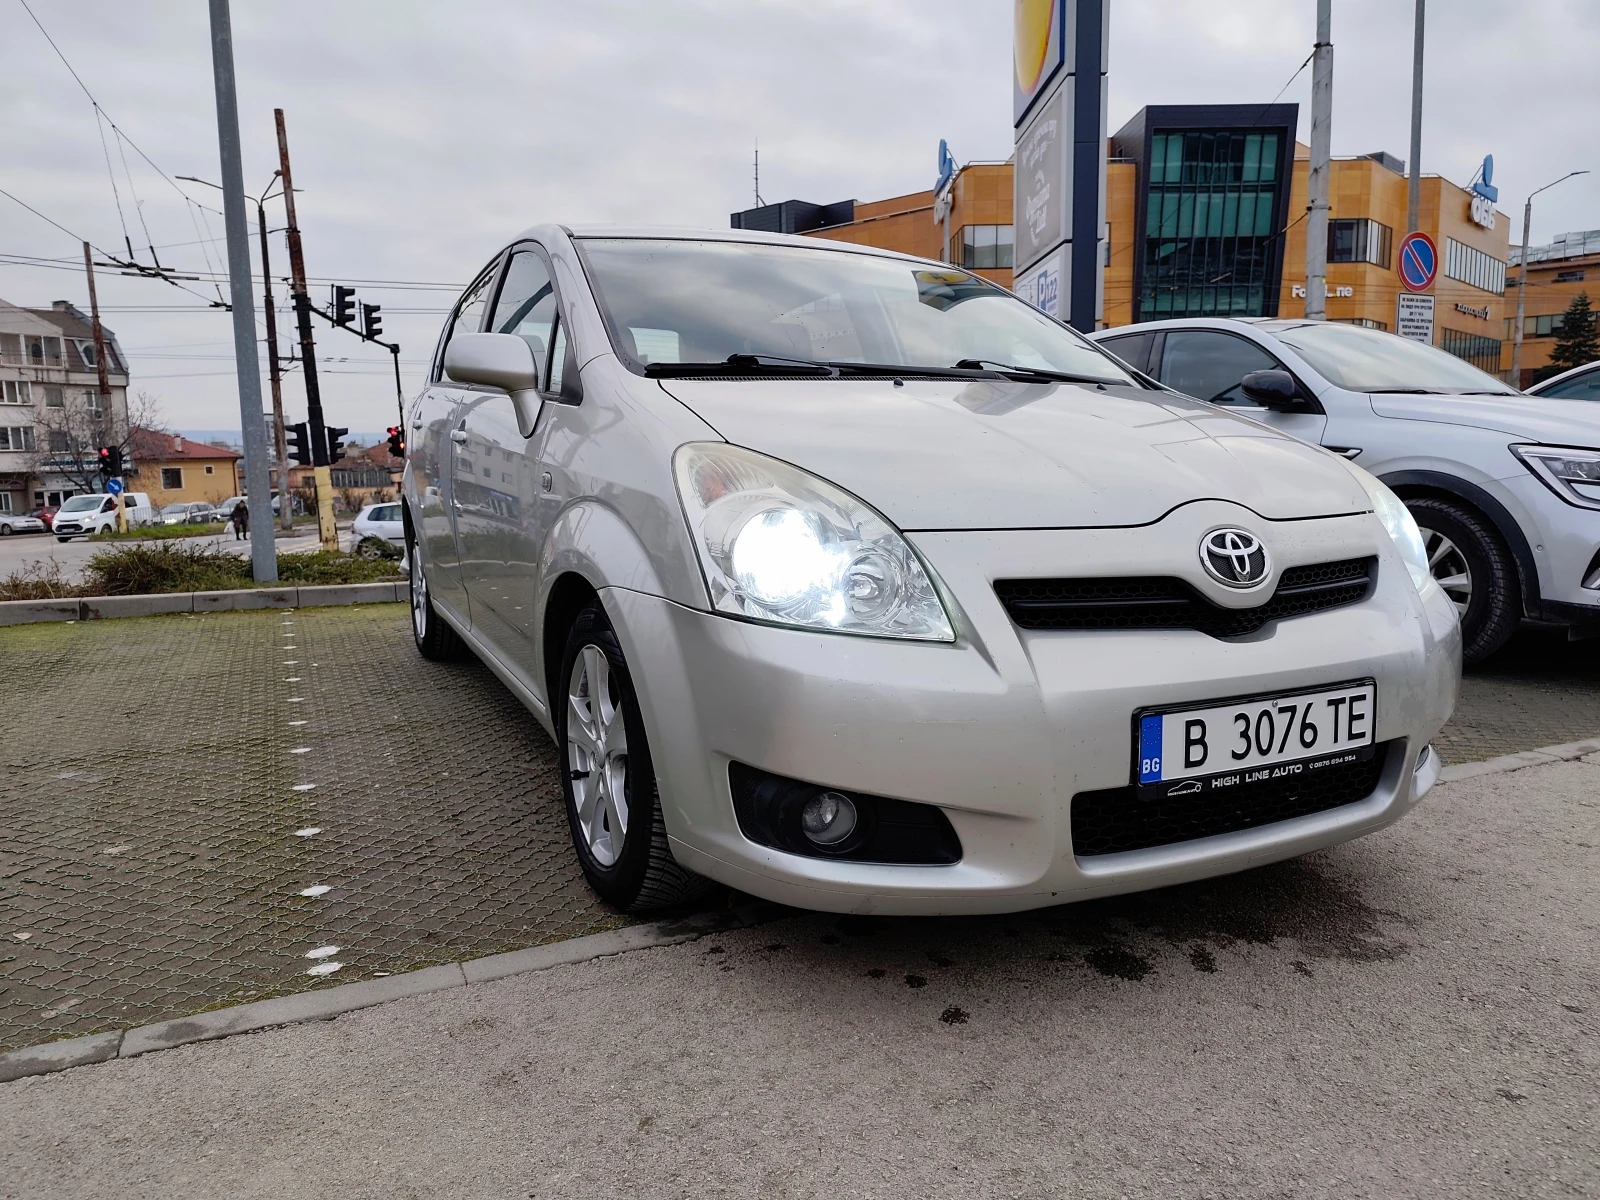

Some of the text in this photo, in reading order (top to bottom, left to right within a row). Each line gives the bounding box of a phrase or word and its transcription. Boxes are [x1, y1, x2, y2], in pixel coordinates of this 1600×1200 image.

[1471, 198, 1496, 230] ОББ
[1142, 694, 1367, 775] BG B 3076 TE
[1211, 764, 1303, 789] HIGH LINE AUTO
